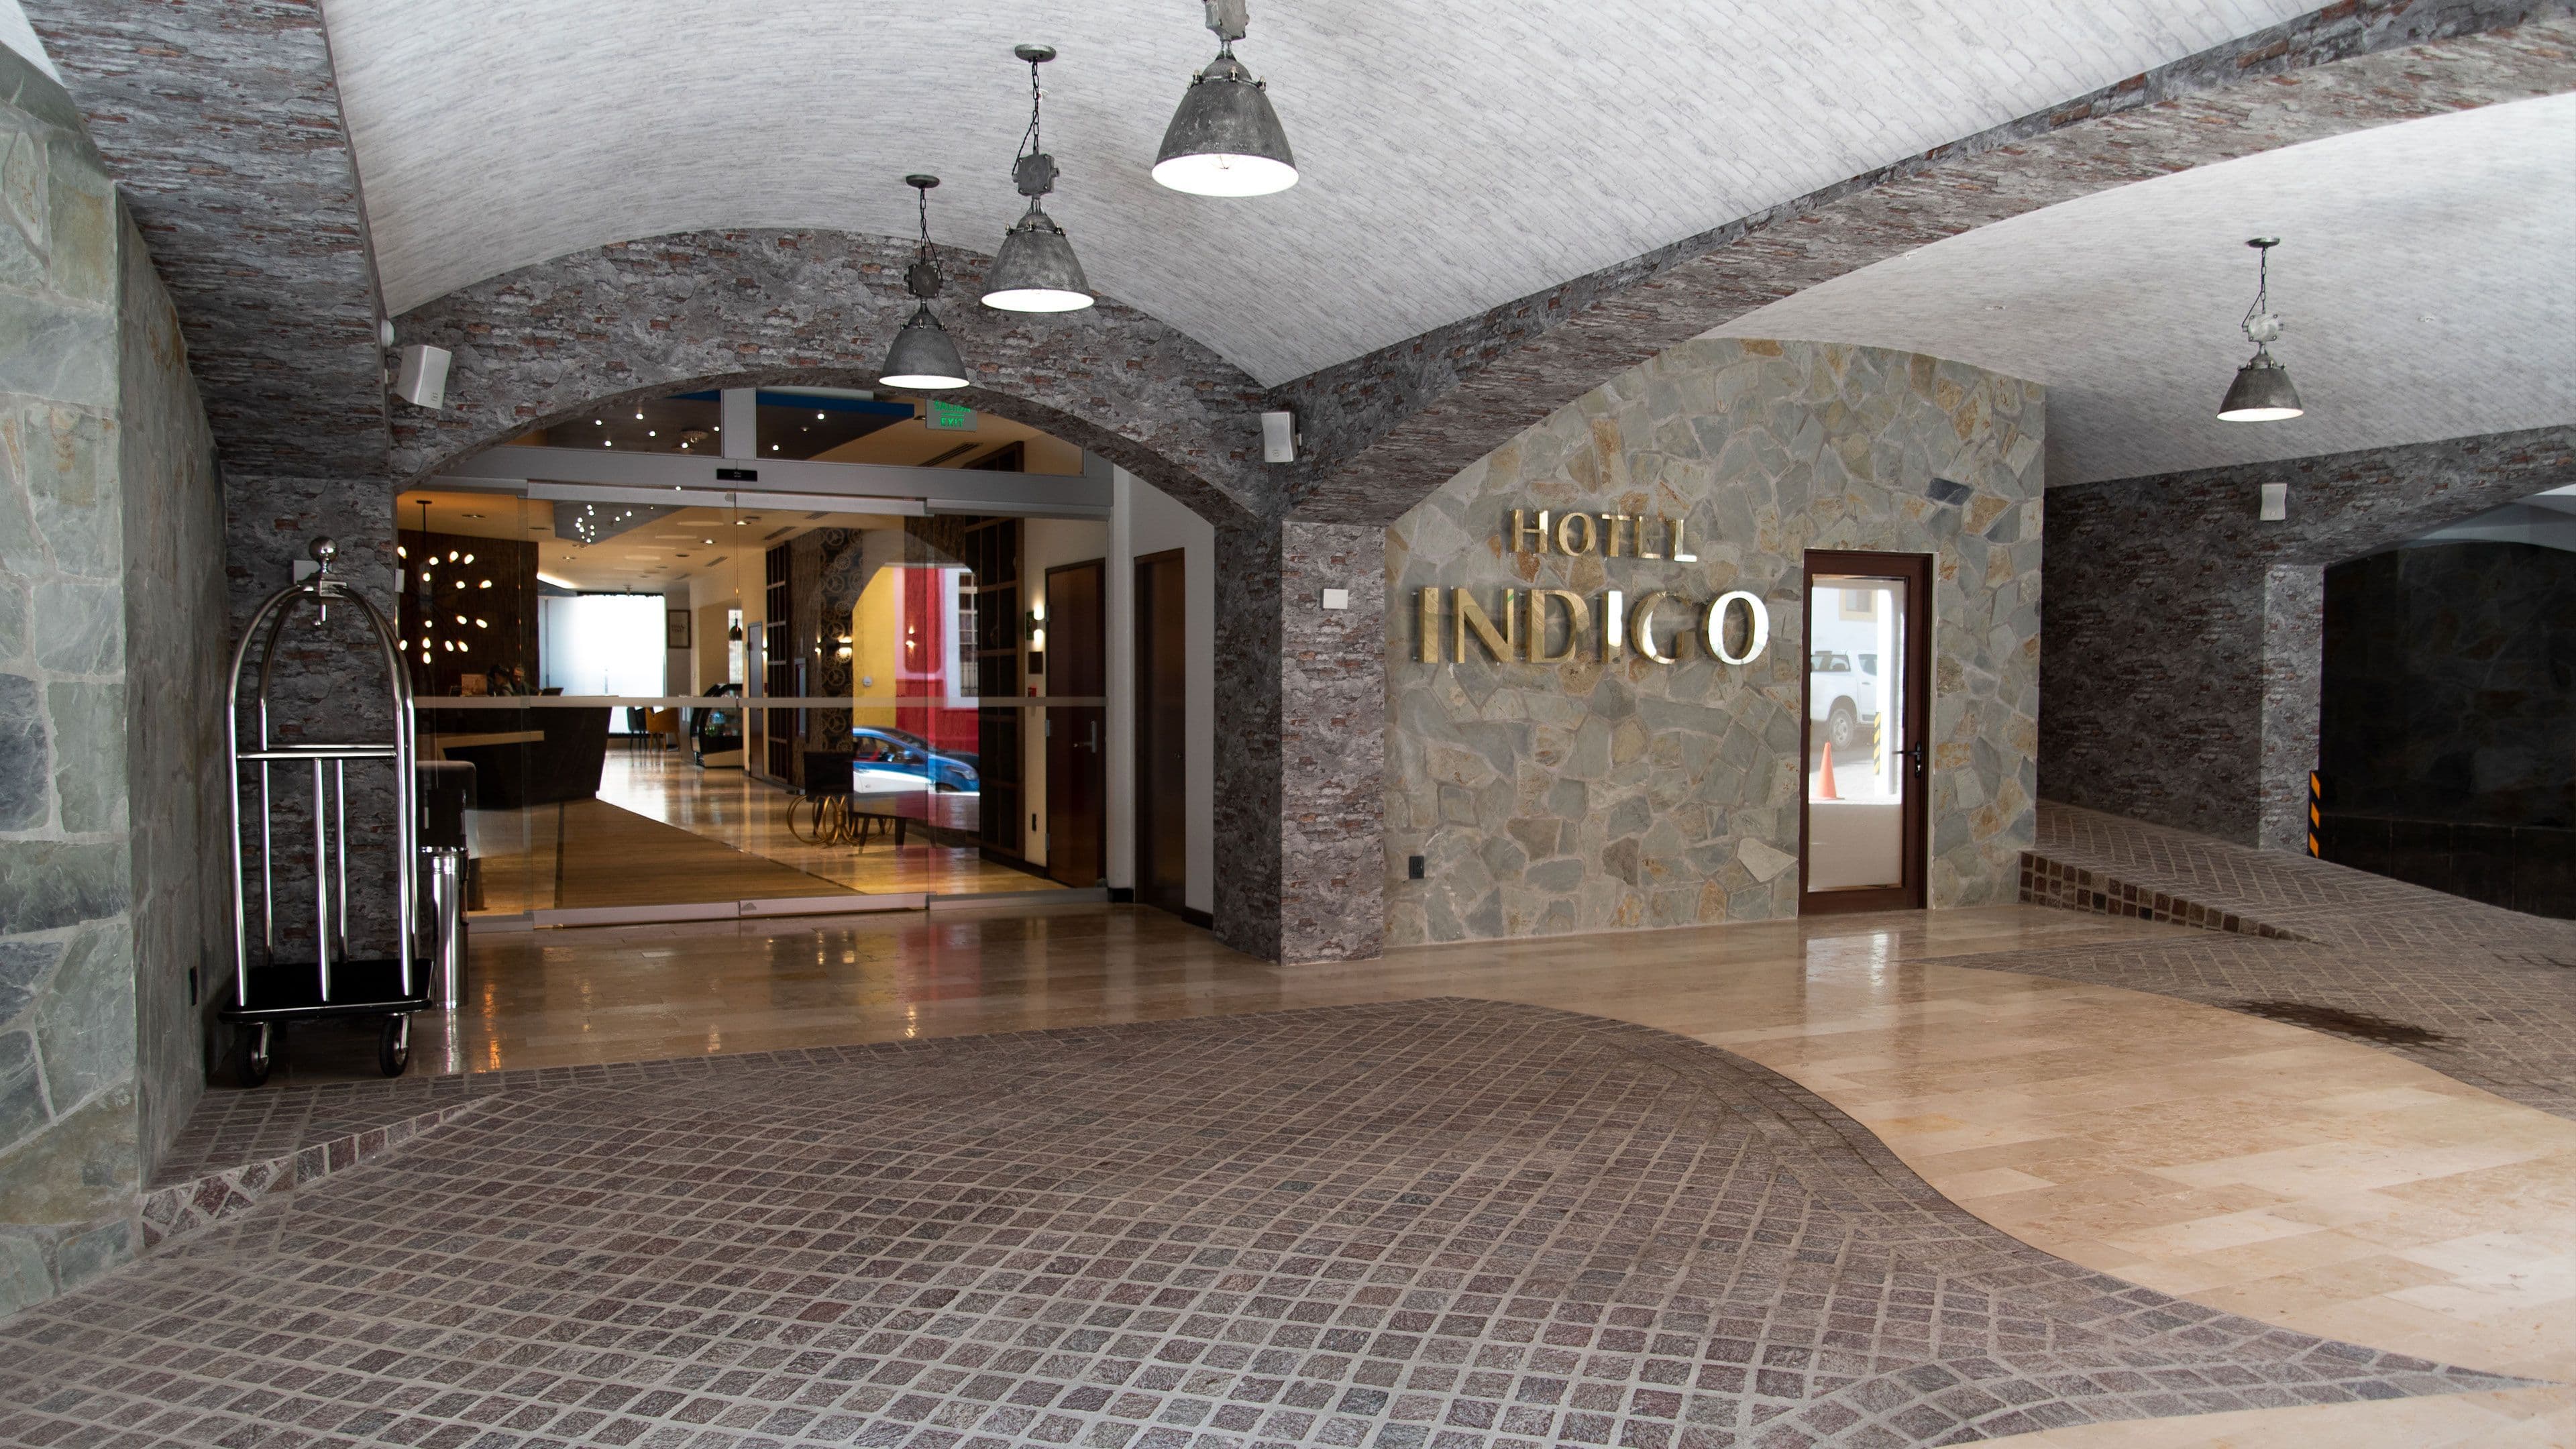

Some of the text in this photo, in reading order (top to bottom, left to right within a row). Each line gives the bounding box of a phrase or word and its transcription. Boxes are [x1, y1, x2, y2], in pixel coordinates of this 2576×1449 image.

[941, 417, 964, 427] EXIT
[1511, 508, 1697, 562] HOTEL
[1419, 587, 1770, 665] INDIGO
